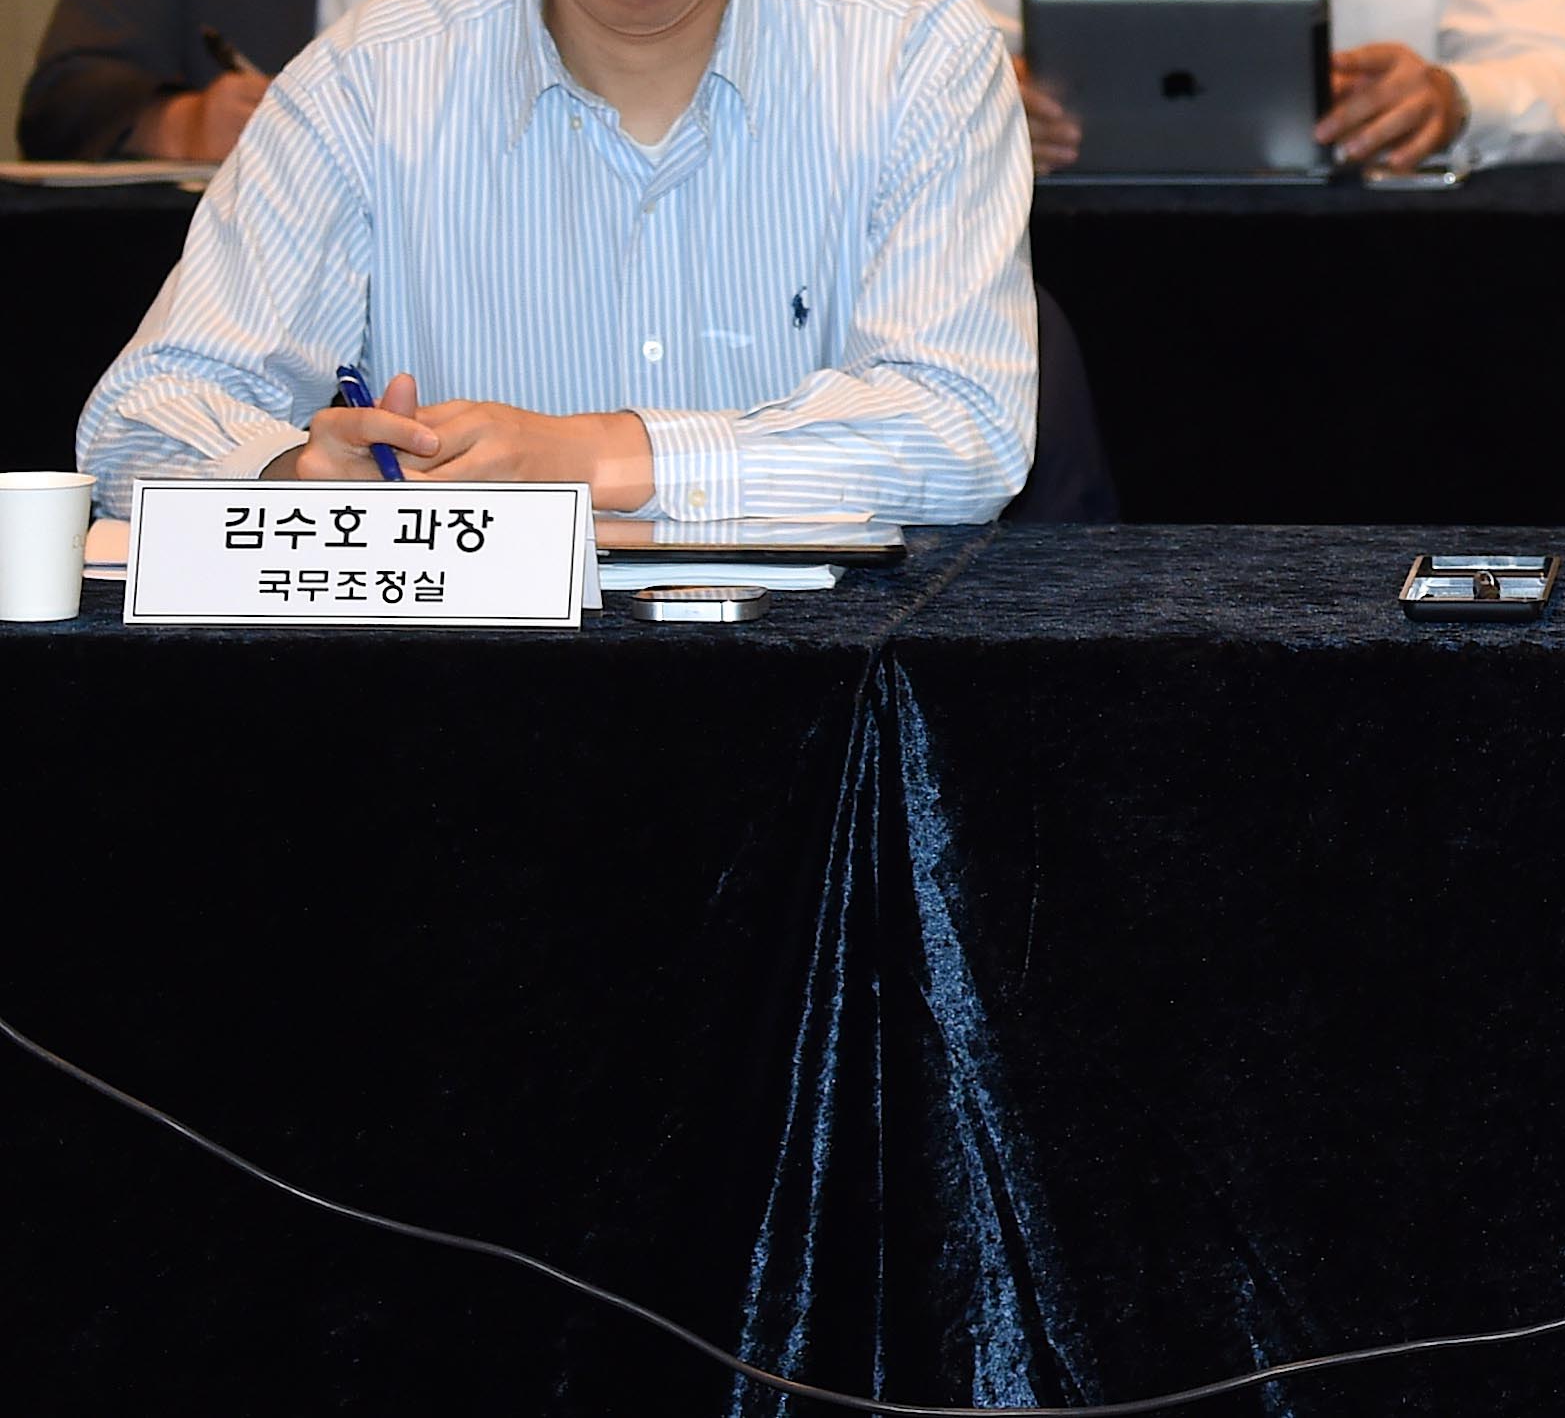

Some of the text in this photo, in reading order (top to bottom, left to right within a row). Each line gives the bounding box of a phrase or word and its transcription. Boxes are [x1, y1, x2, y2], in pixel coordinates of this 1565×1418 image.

[225, 505, 494, 553] 김수호 과장
[258, 569, 445, 604] 국무조정실
